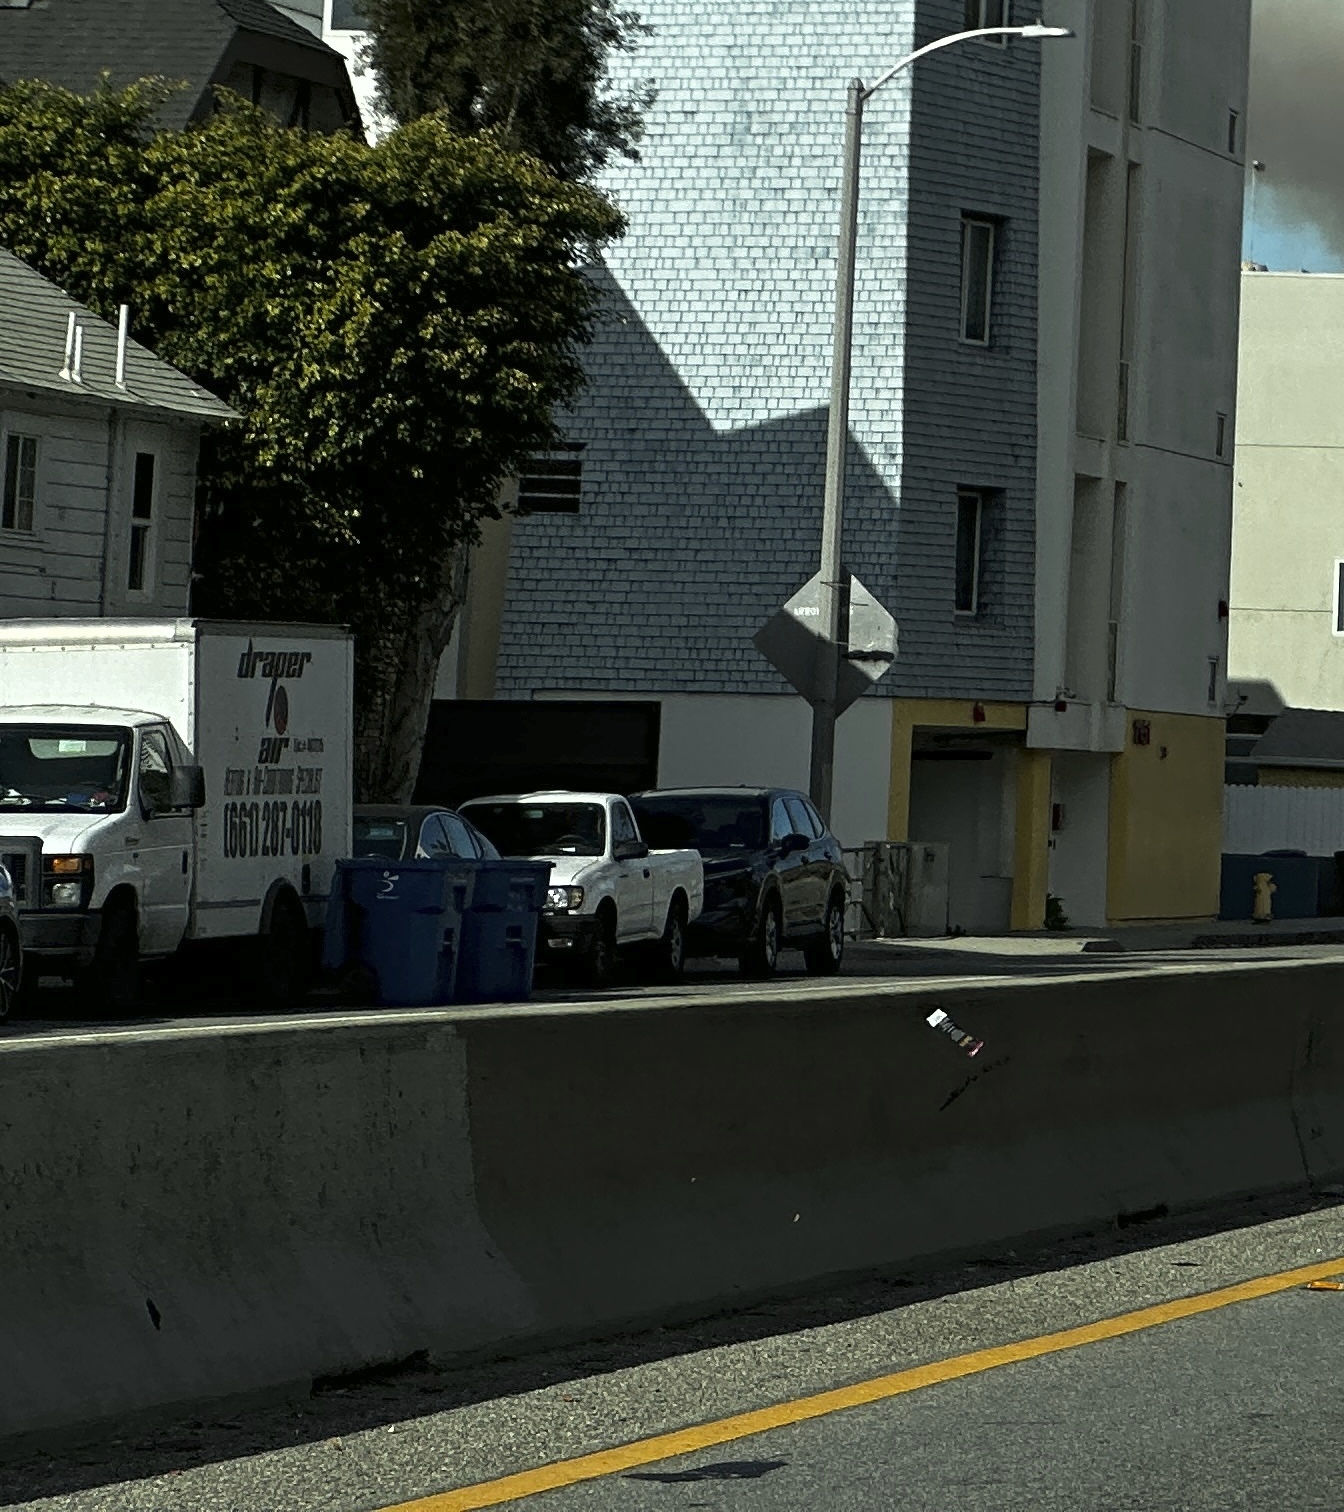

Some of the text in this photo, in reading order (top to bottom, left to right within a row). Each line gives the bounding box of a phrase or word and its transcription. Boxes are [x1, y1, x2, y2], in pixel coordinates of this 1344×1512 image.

[237, 637, 312, 729] draper
[258, 737, 290, 764] air
[224, 801, 260, 859] (661)
[261, 799, 322, 857] 287-0118
